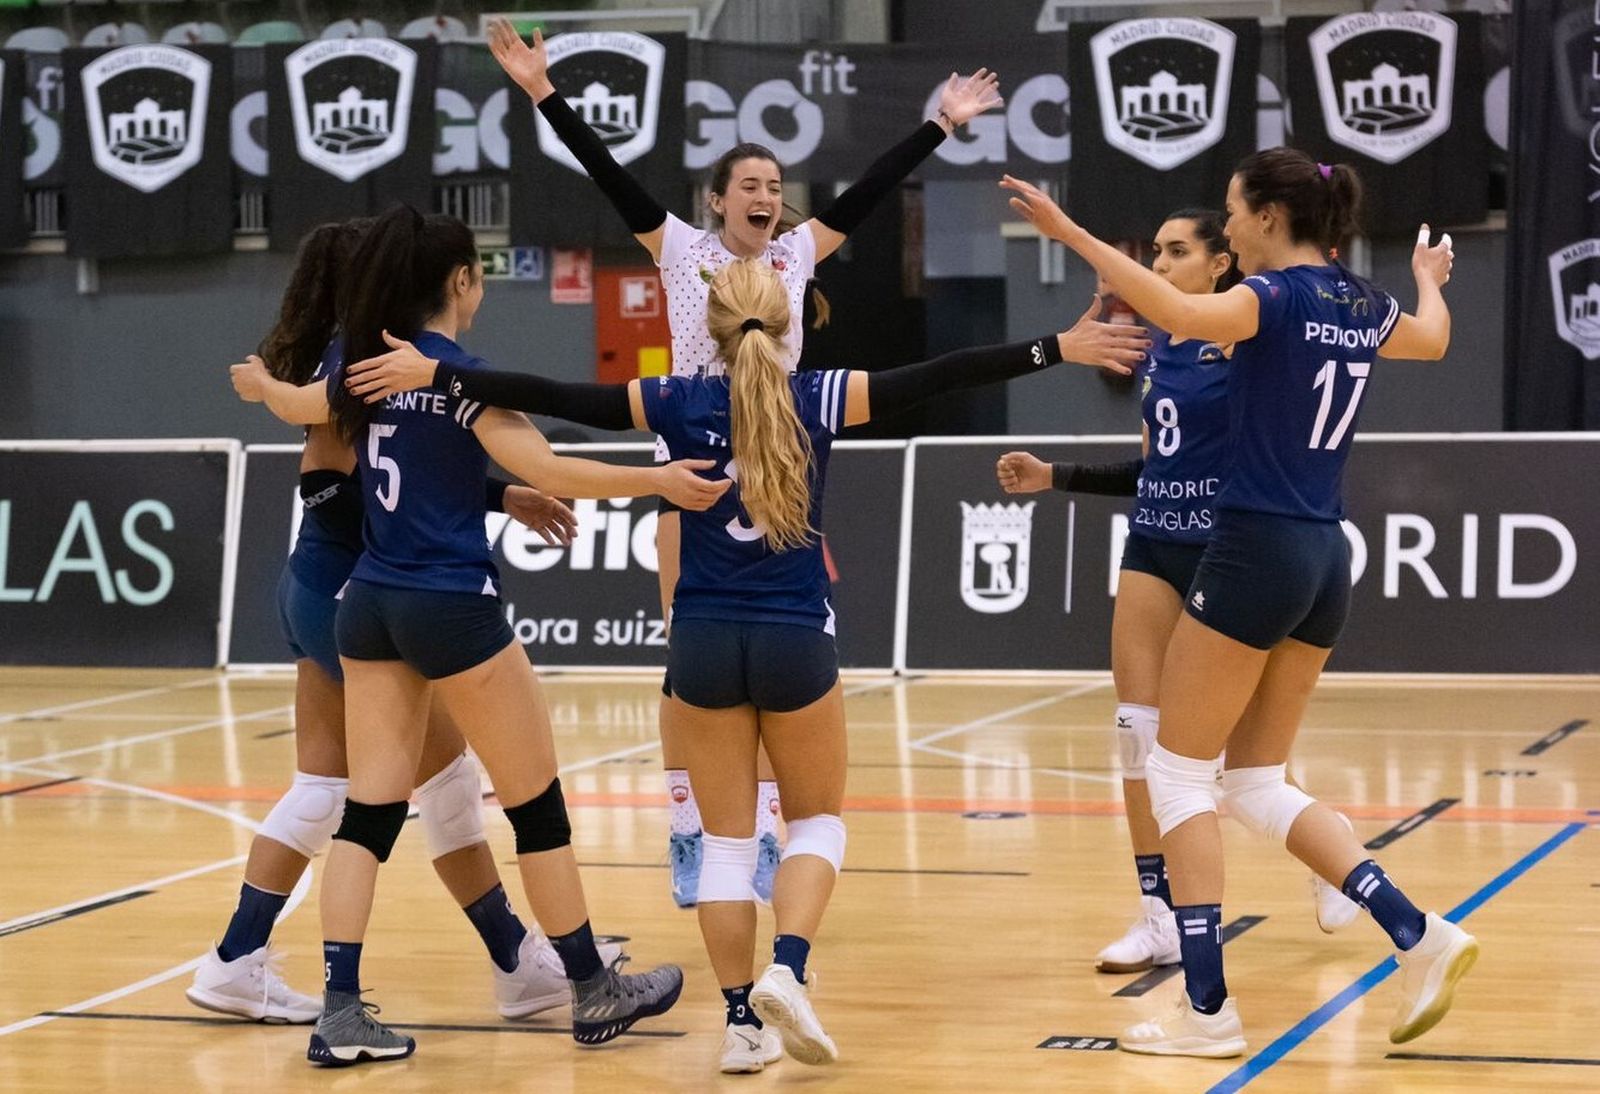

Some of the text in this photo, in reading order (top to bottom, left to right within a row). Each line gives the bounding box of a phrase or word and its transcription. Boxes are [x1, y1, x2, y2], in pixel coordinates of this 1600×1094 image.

[1110, 19, 1217, 44] MADRID CIUDAD
[1328, 14, 1380, 40] MADRID
[800, 50, 858, 96] fit
[683, 79, 824, 169] GO
[1155, 398, 1181, 457] 8
[1308, 360, 1372, 451] 17
[367, 423, 401, 513] 5
[0, 499, 175, 606] LAS
